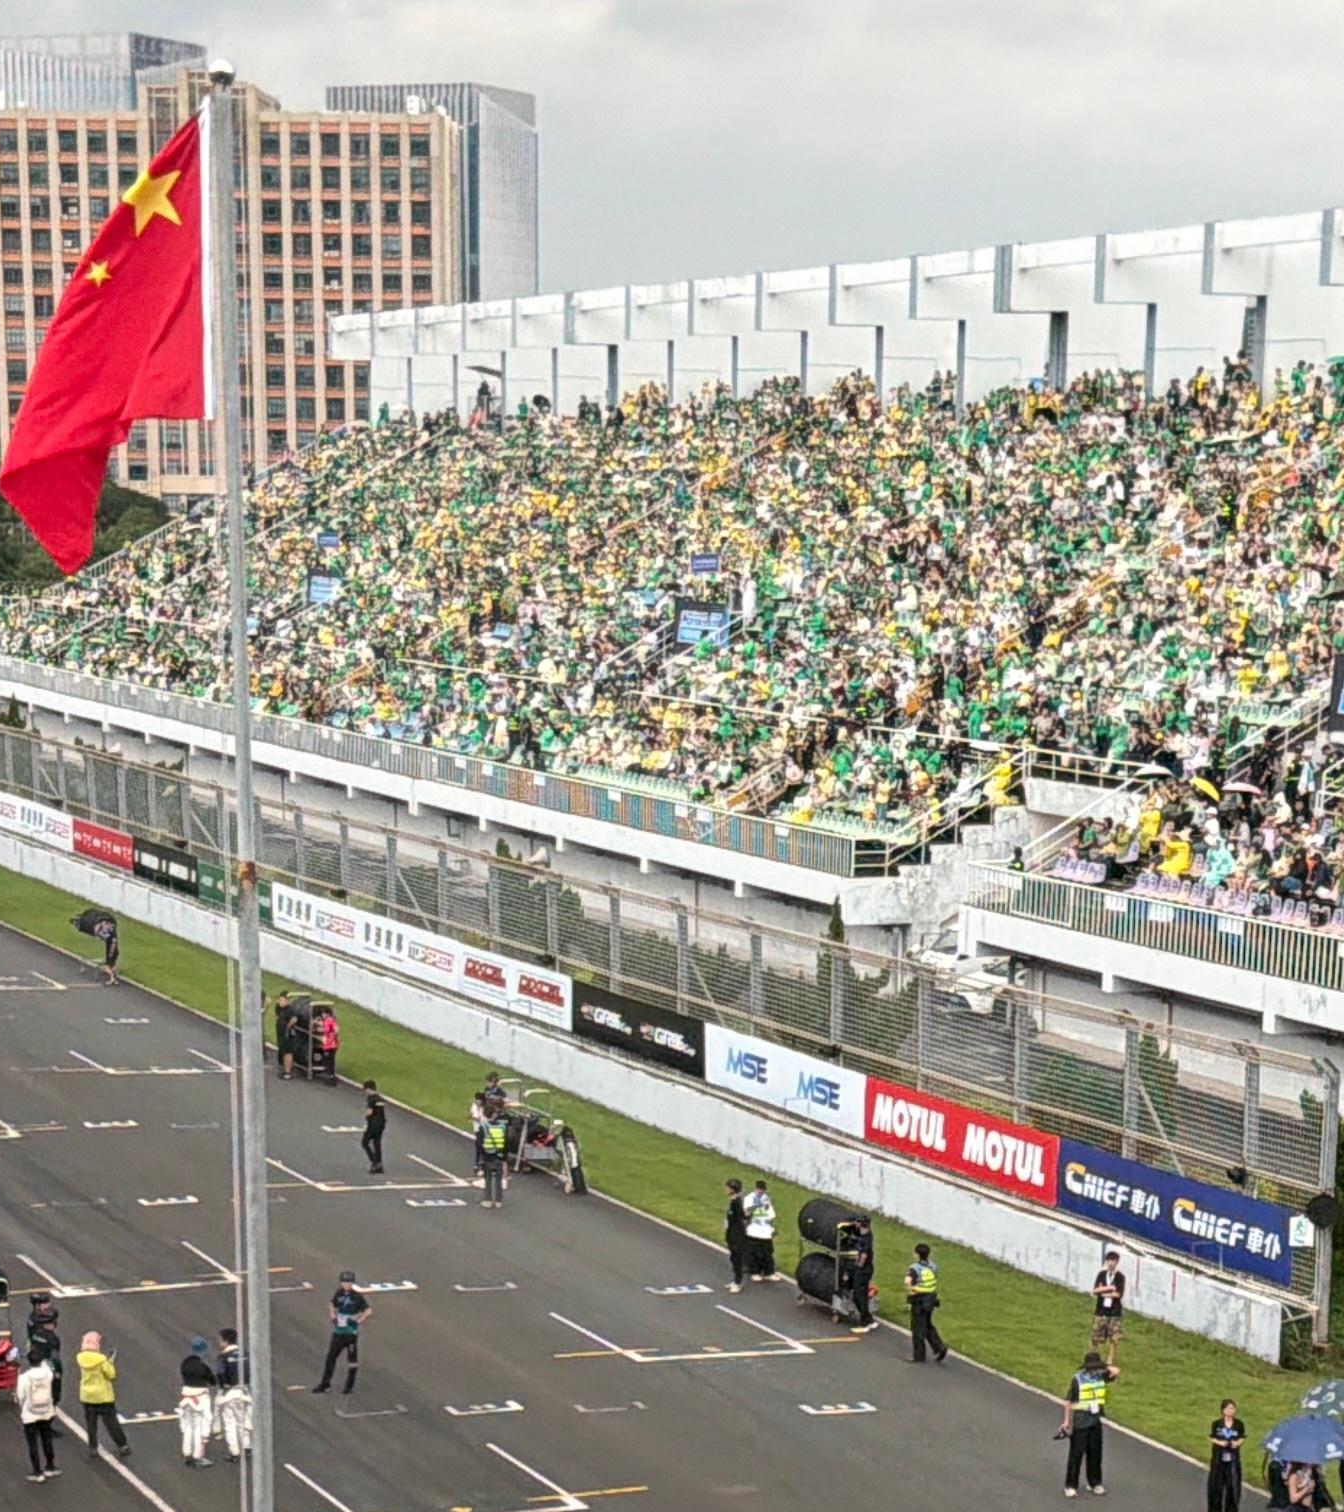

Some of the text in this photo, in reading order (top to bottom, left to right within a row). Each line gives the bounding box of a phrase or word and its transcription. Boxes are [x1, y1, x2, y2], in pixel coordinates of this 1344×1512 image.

[726, 1046, 768, 1084] MSE
[797, 1071, 840, 1111] MSE
[872, 1093, 1045, 1187] MOTUL MOTUL
[1065, 1162, 1129, 1209] CHIEF
[1173, 1198, 1245, 1248] CHIEF
